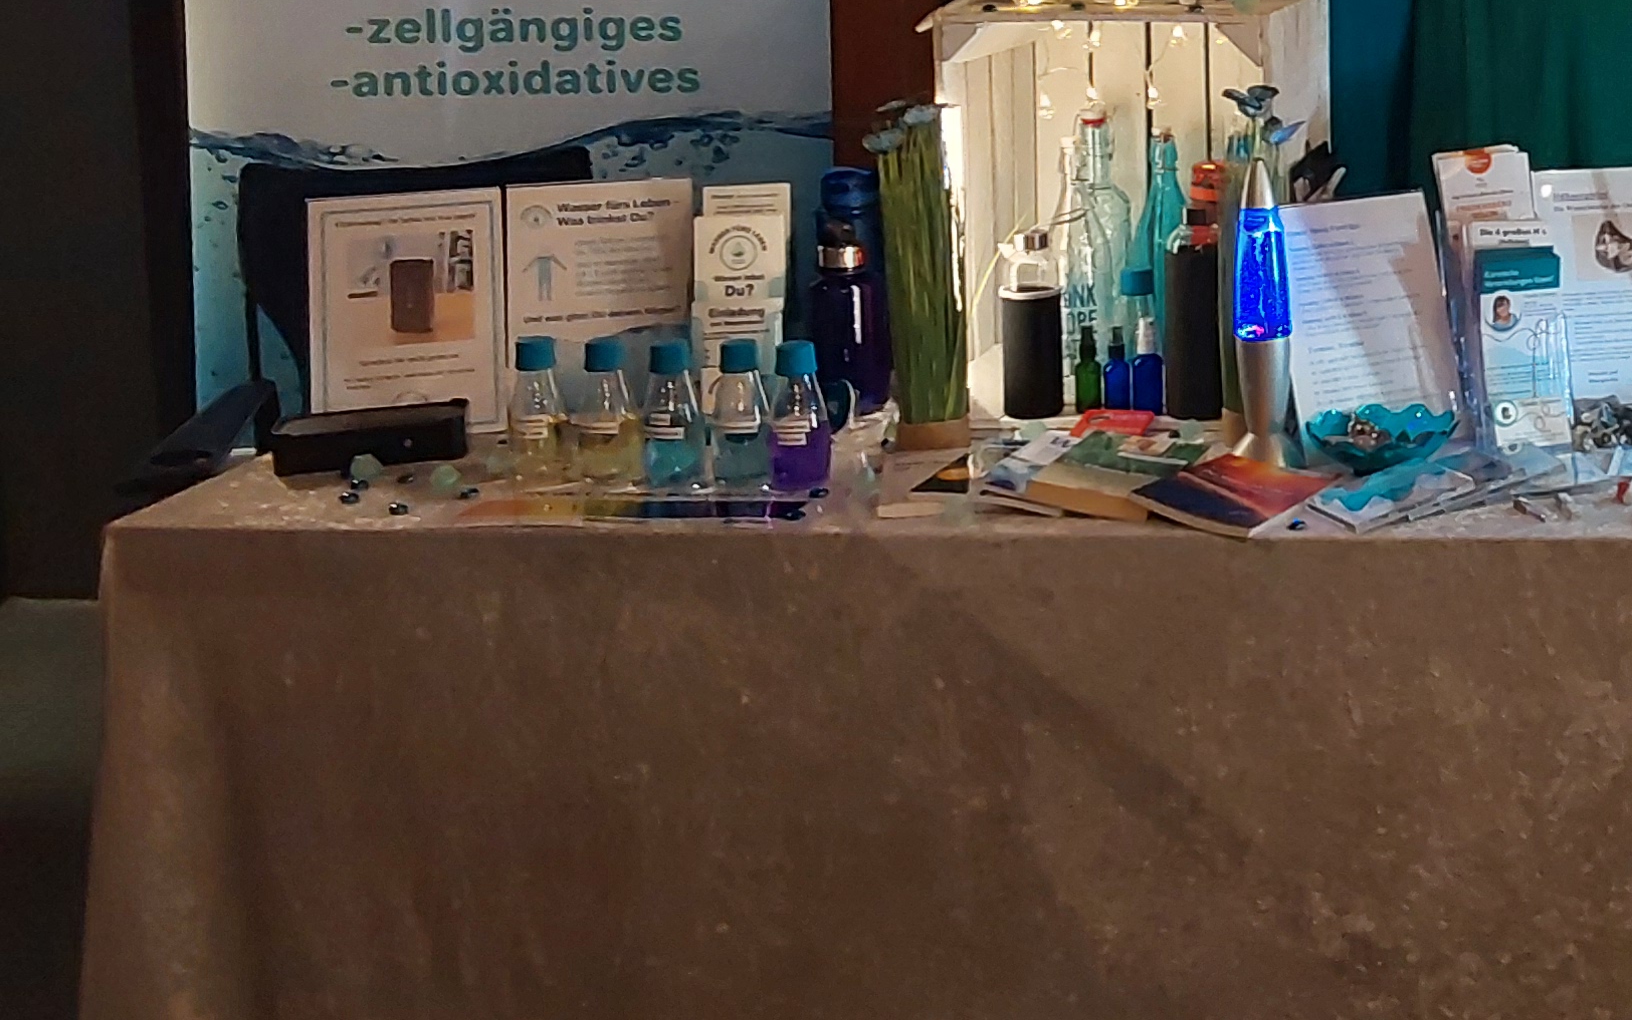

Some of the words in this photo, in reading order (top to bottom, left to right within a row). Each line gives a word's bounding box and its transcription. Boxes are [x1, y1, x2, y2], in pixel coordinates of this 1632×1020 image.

[345, 8, 683, 52] -zellgängiges
[330, 60, 701, 97] -antioxidatives
[725, 284, 754, 296] Du?
